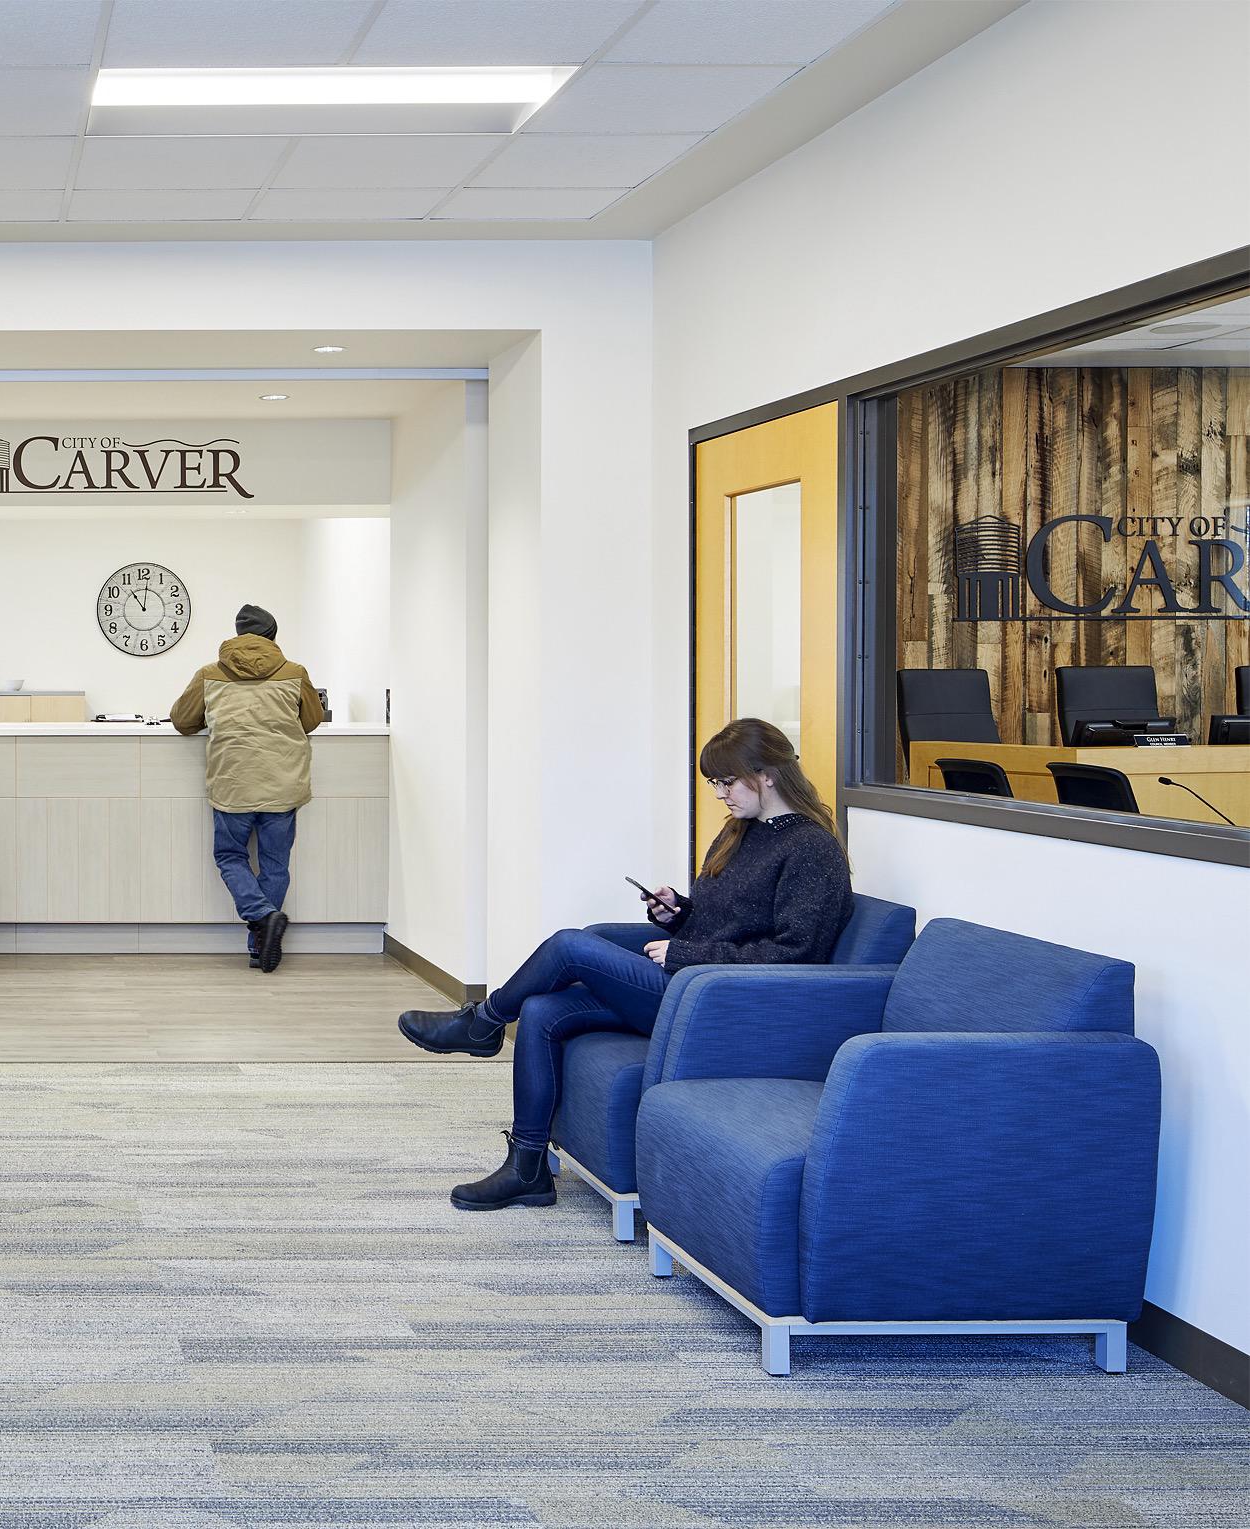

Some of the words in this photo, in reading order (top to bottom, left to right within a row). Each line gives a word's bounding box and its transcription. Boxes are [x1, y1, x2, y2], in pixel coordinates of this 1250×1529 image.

[61, 436, 97, 449] CITY
[100, 436, 121, 449] OF
[12, 435, 255, 499] CARVER
[1117, 516, 1184, 537] CITY
[1189, 516, 1226, 537] OF
[122, 573, 131, 585] 11
[137, 568, 151, 581] 12
[159, 573, 163, 584] 1
[107, 586, 120, 598] 10
[170, 585, 180, 597] 2
[104, 604, 113, 616] 9
[175, 604, 183, 615] 3
[109, 622, 117, 634] 8
[171, 622, 179, 634] 4
[123, 635, 131, 647] 7
[140, 639, 149, 651] 6
[158, 635, 166, 646] 5
